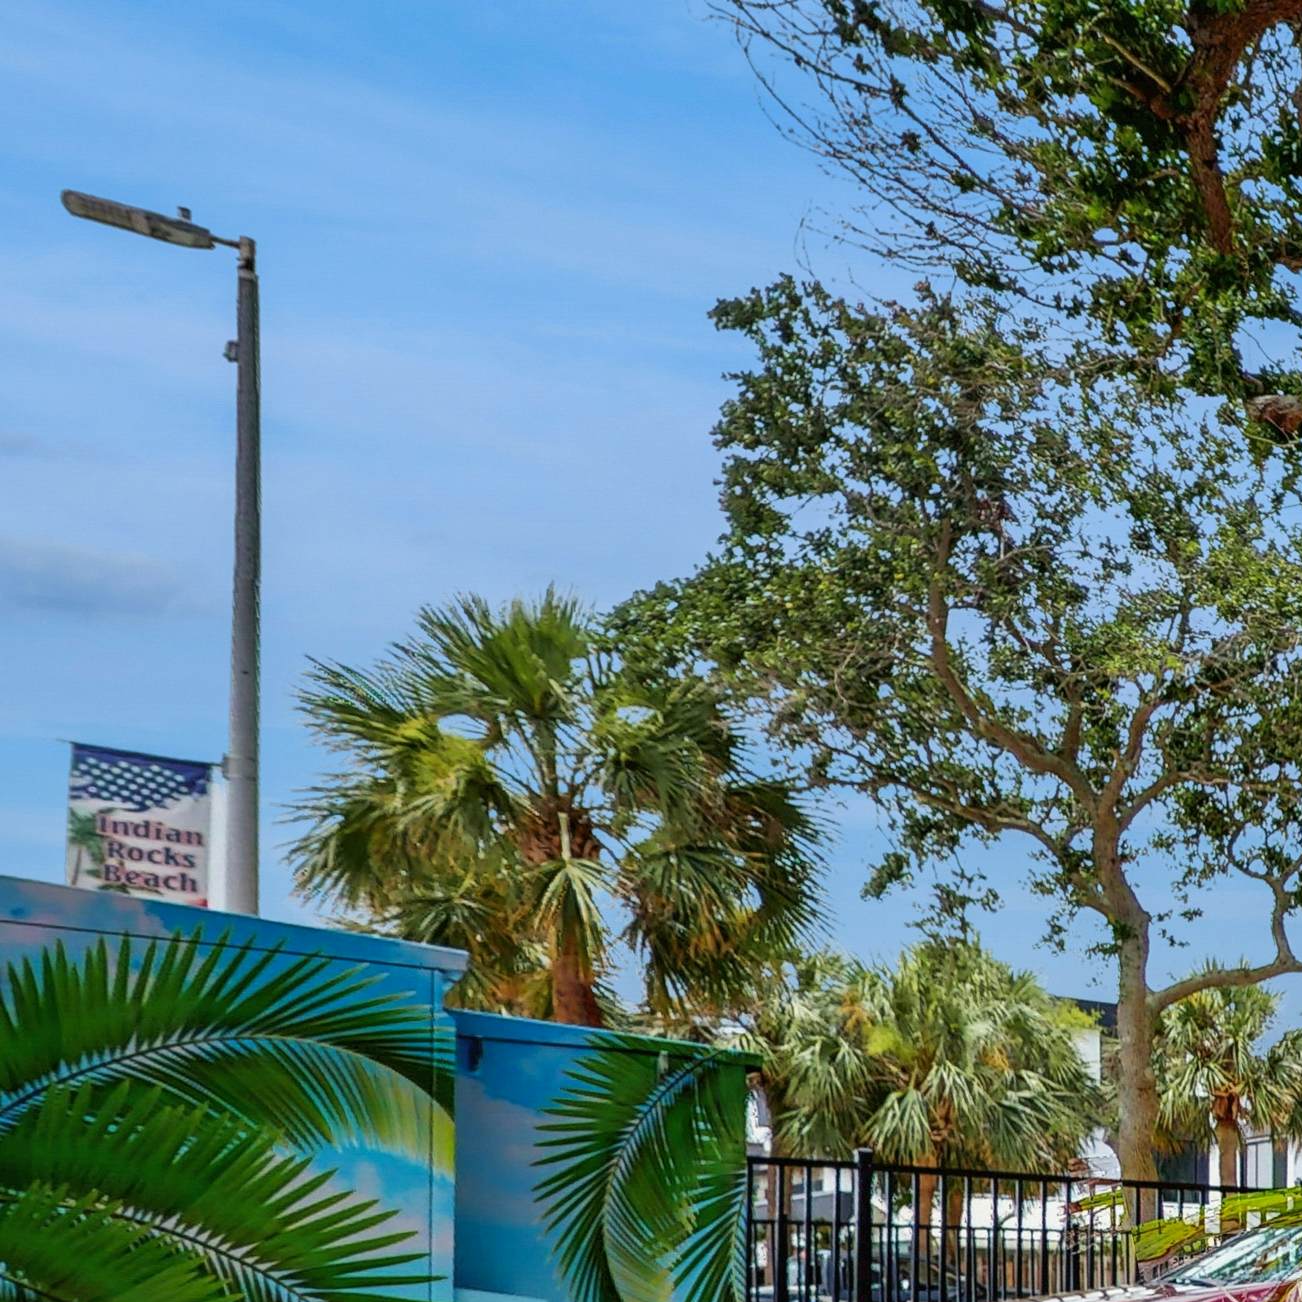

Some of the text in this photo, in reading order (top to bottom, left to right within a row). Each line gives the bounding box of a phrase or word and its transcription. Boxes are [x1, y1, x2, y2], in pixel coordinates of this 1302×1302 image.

[99, 816, 203, 845] Indian
[107, 841, 196, 868] Rocks
[104, 863, 198, 892] Beach
